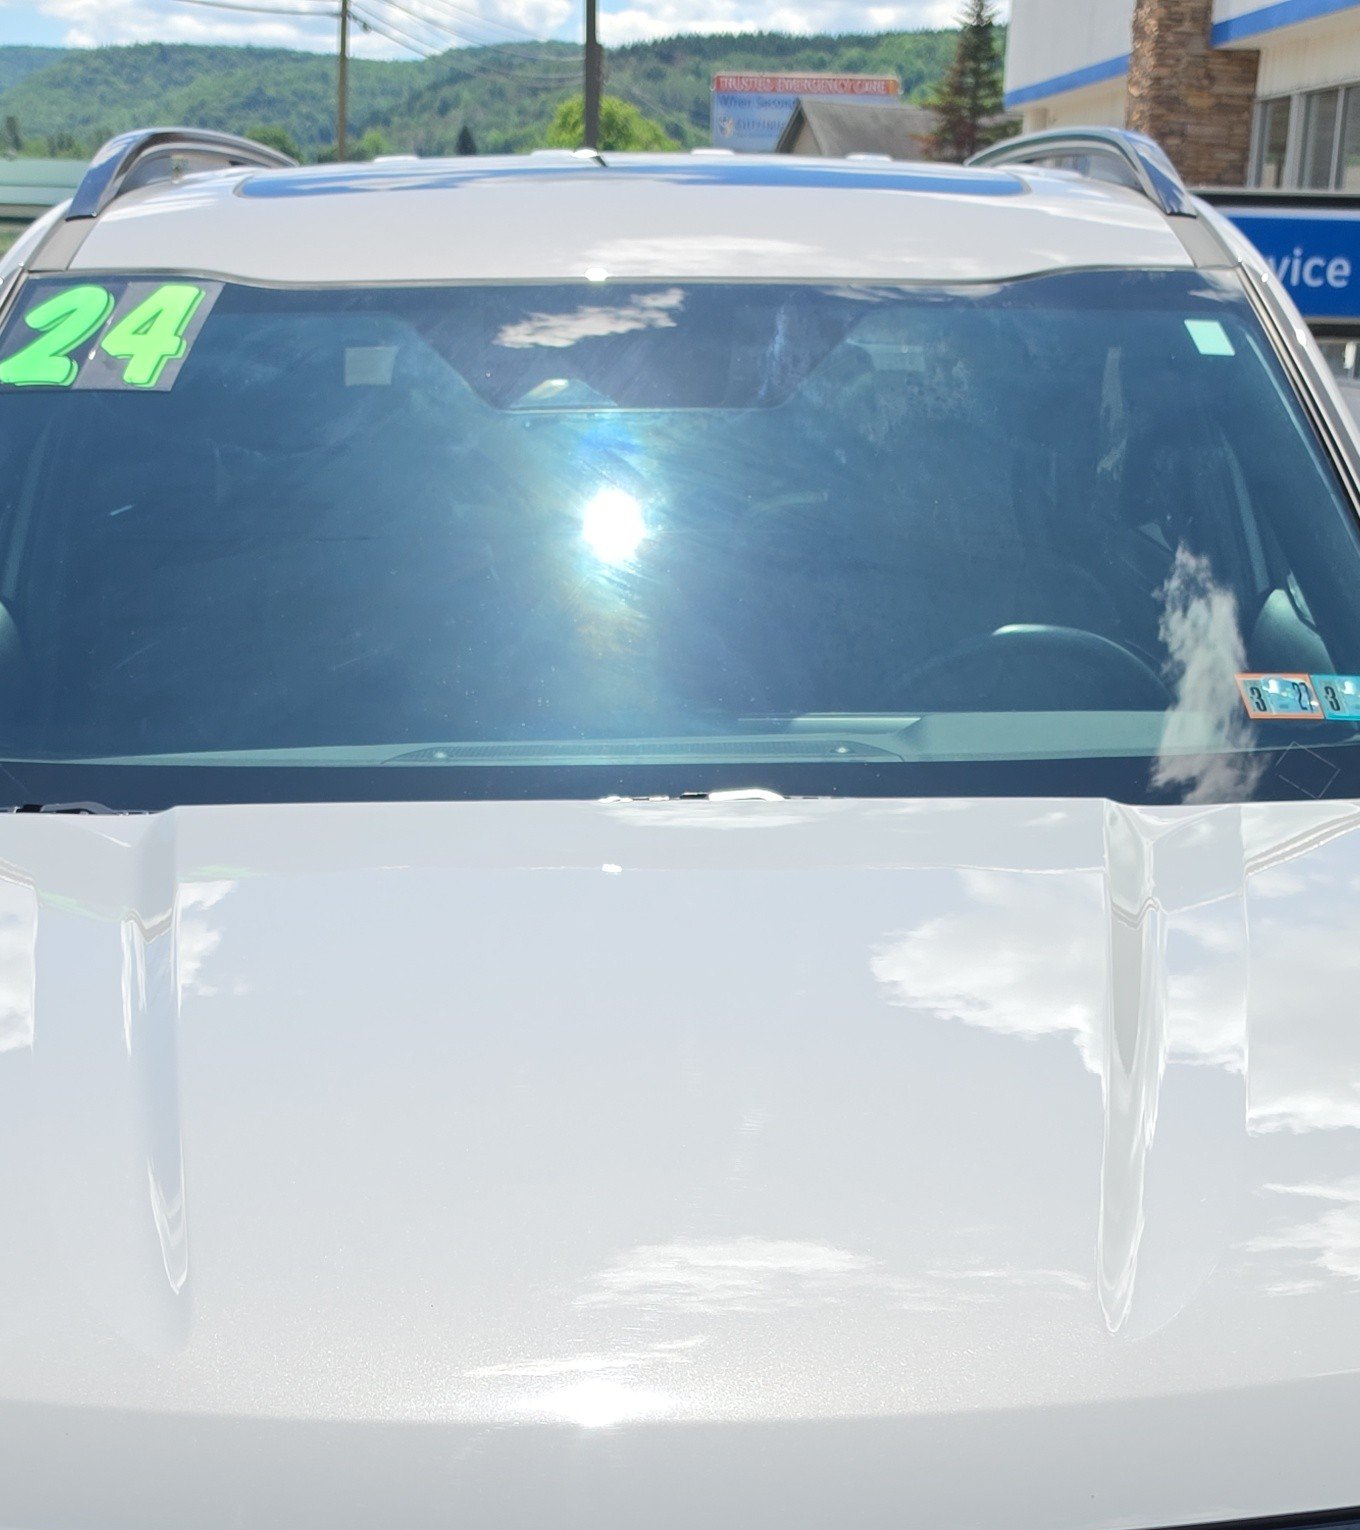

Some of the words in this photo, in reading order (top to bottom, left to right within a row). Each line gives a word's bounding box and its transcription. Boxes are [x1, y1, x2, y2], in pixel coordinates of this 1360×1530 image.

[853, 79, 887, 94] CARE
[1250, 686, 1267, 712] 3
[1292, 682, 1314, 713] 27
[1324, 686, 1341, 712] 3
